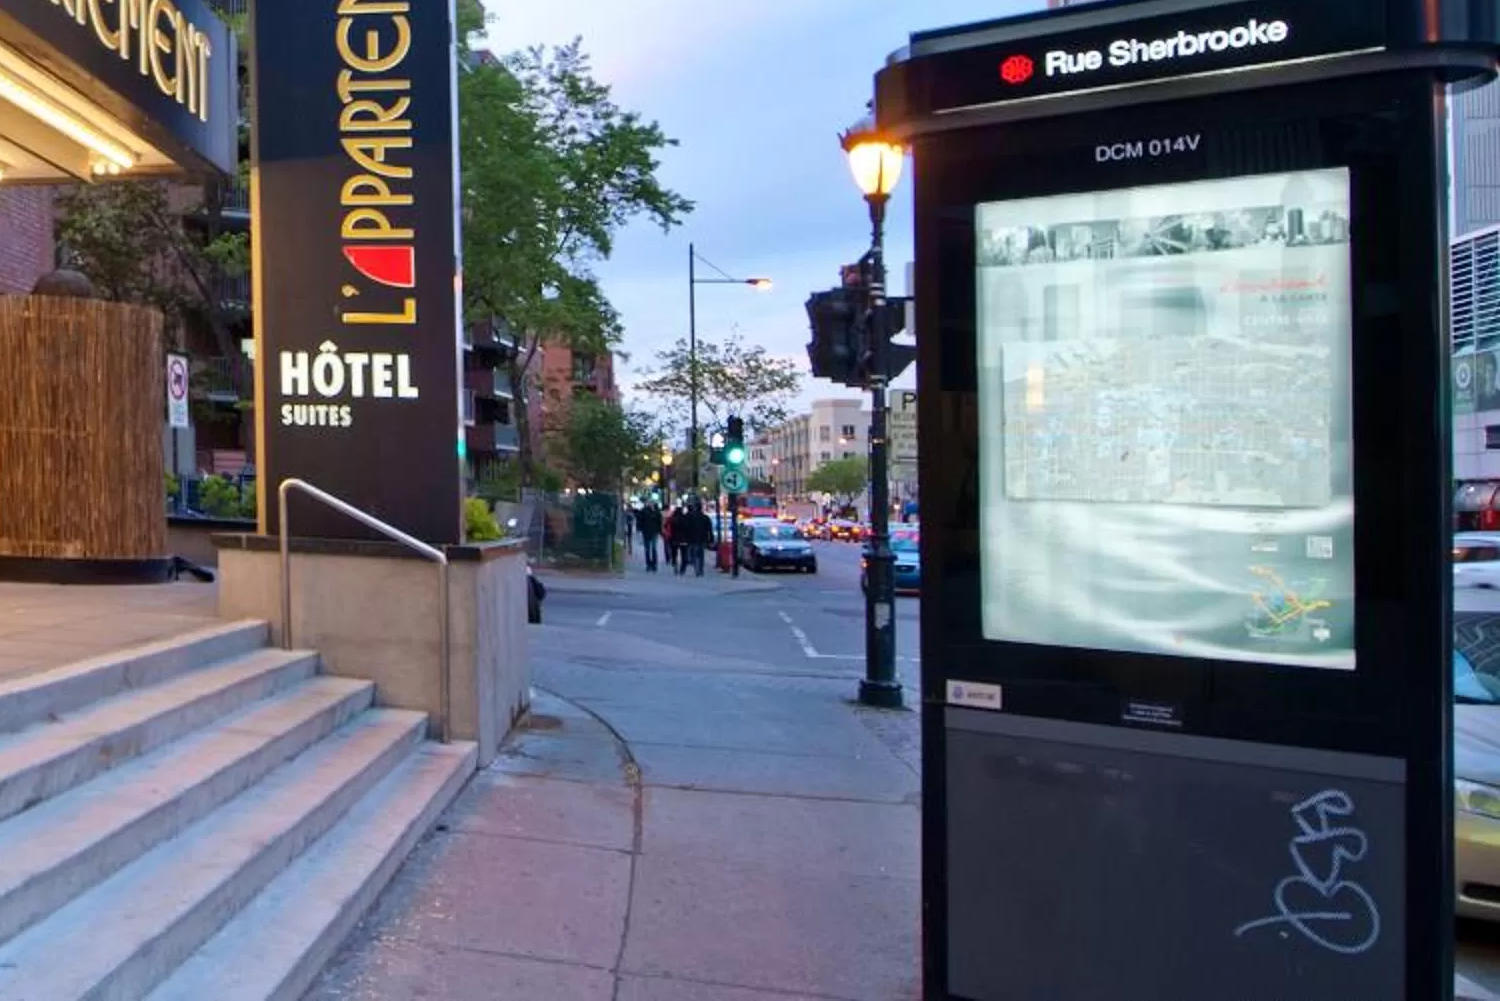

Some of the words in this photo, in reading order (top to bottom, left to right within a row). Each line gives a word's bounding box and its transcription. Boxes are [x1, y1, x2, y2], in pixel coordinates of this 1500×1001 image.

[1044, 50, 1103, 77] Rue
[1108, 18, 1289, 67] Sherbrooke
[1095, 142, 1143, 162] DCM
[1148, 134, 1201, 157] 014V
[280, 339, 419, 398] HÔTEL
[281, 403, 352, 428] SUITES
